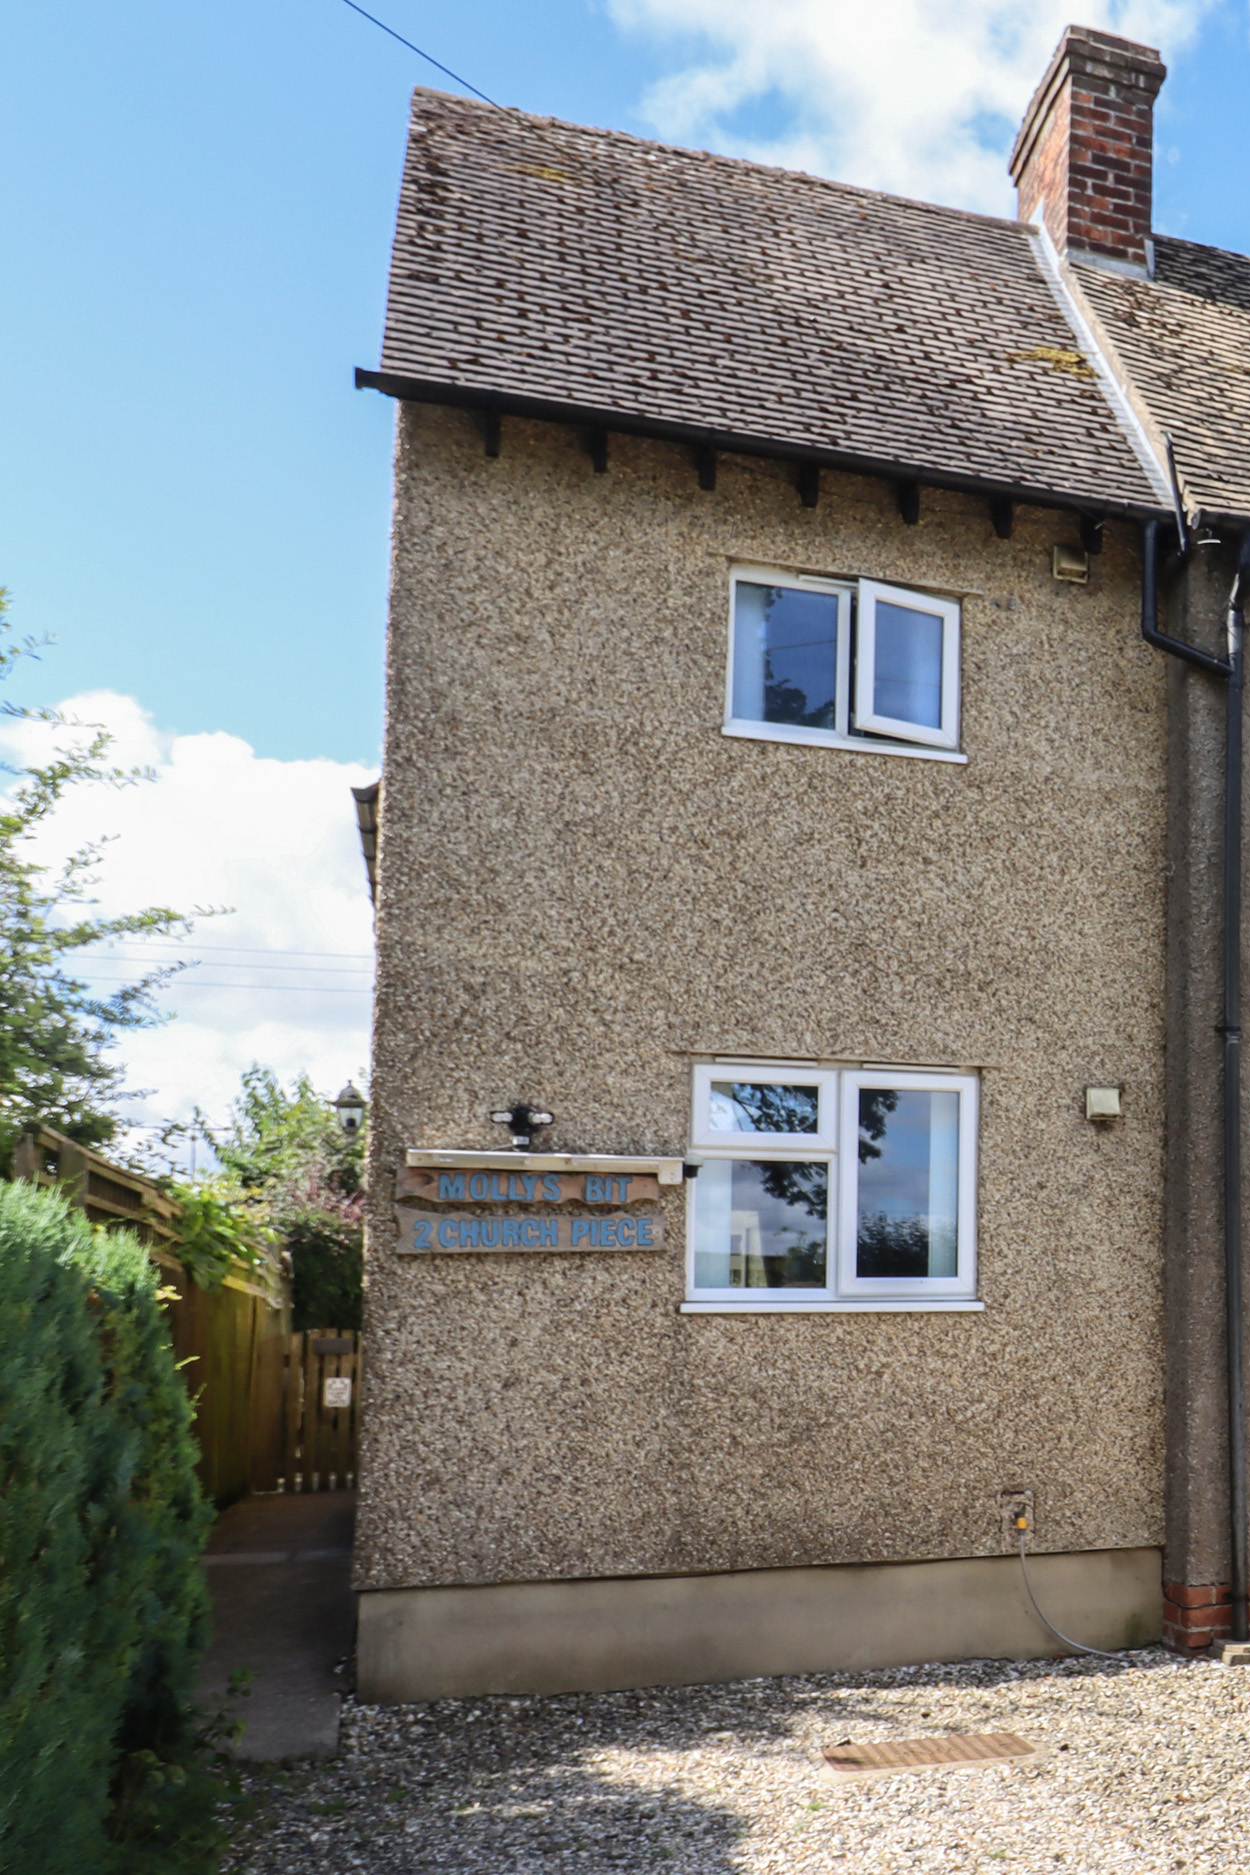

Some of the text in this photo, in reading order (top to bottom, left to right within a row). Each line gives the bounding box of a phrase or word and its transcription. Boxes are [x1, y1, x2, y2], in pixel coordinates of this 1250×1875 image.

[585, 1176, 632, 1203] BIT
[413, 1218, 654, 1249] 2 CHURCH PIECE
